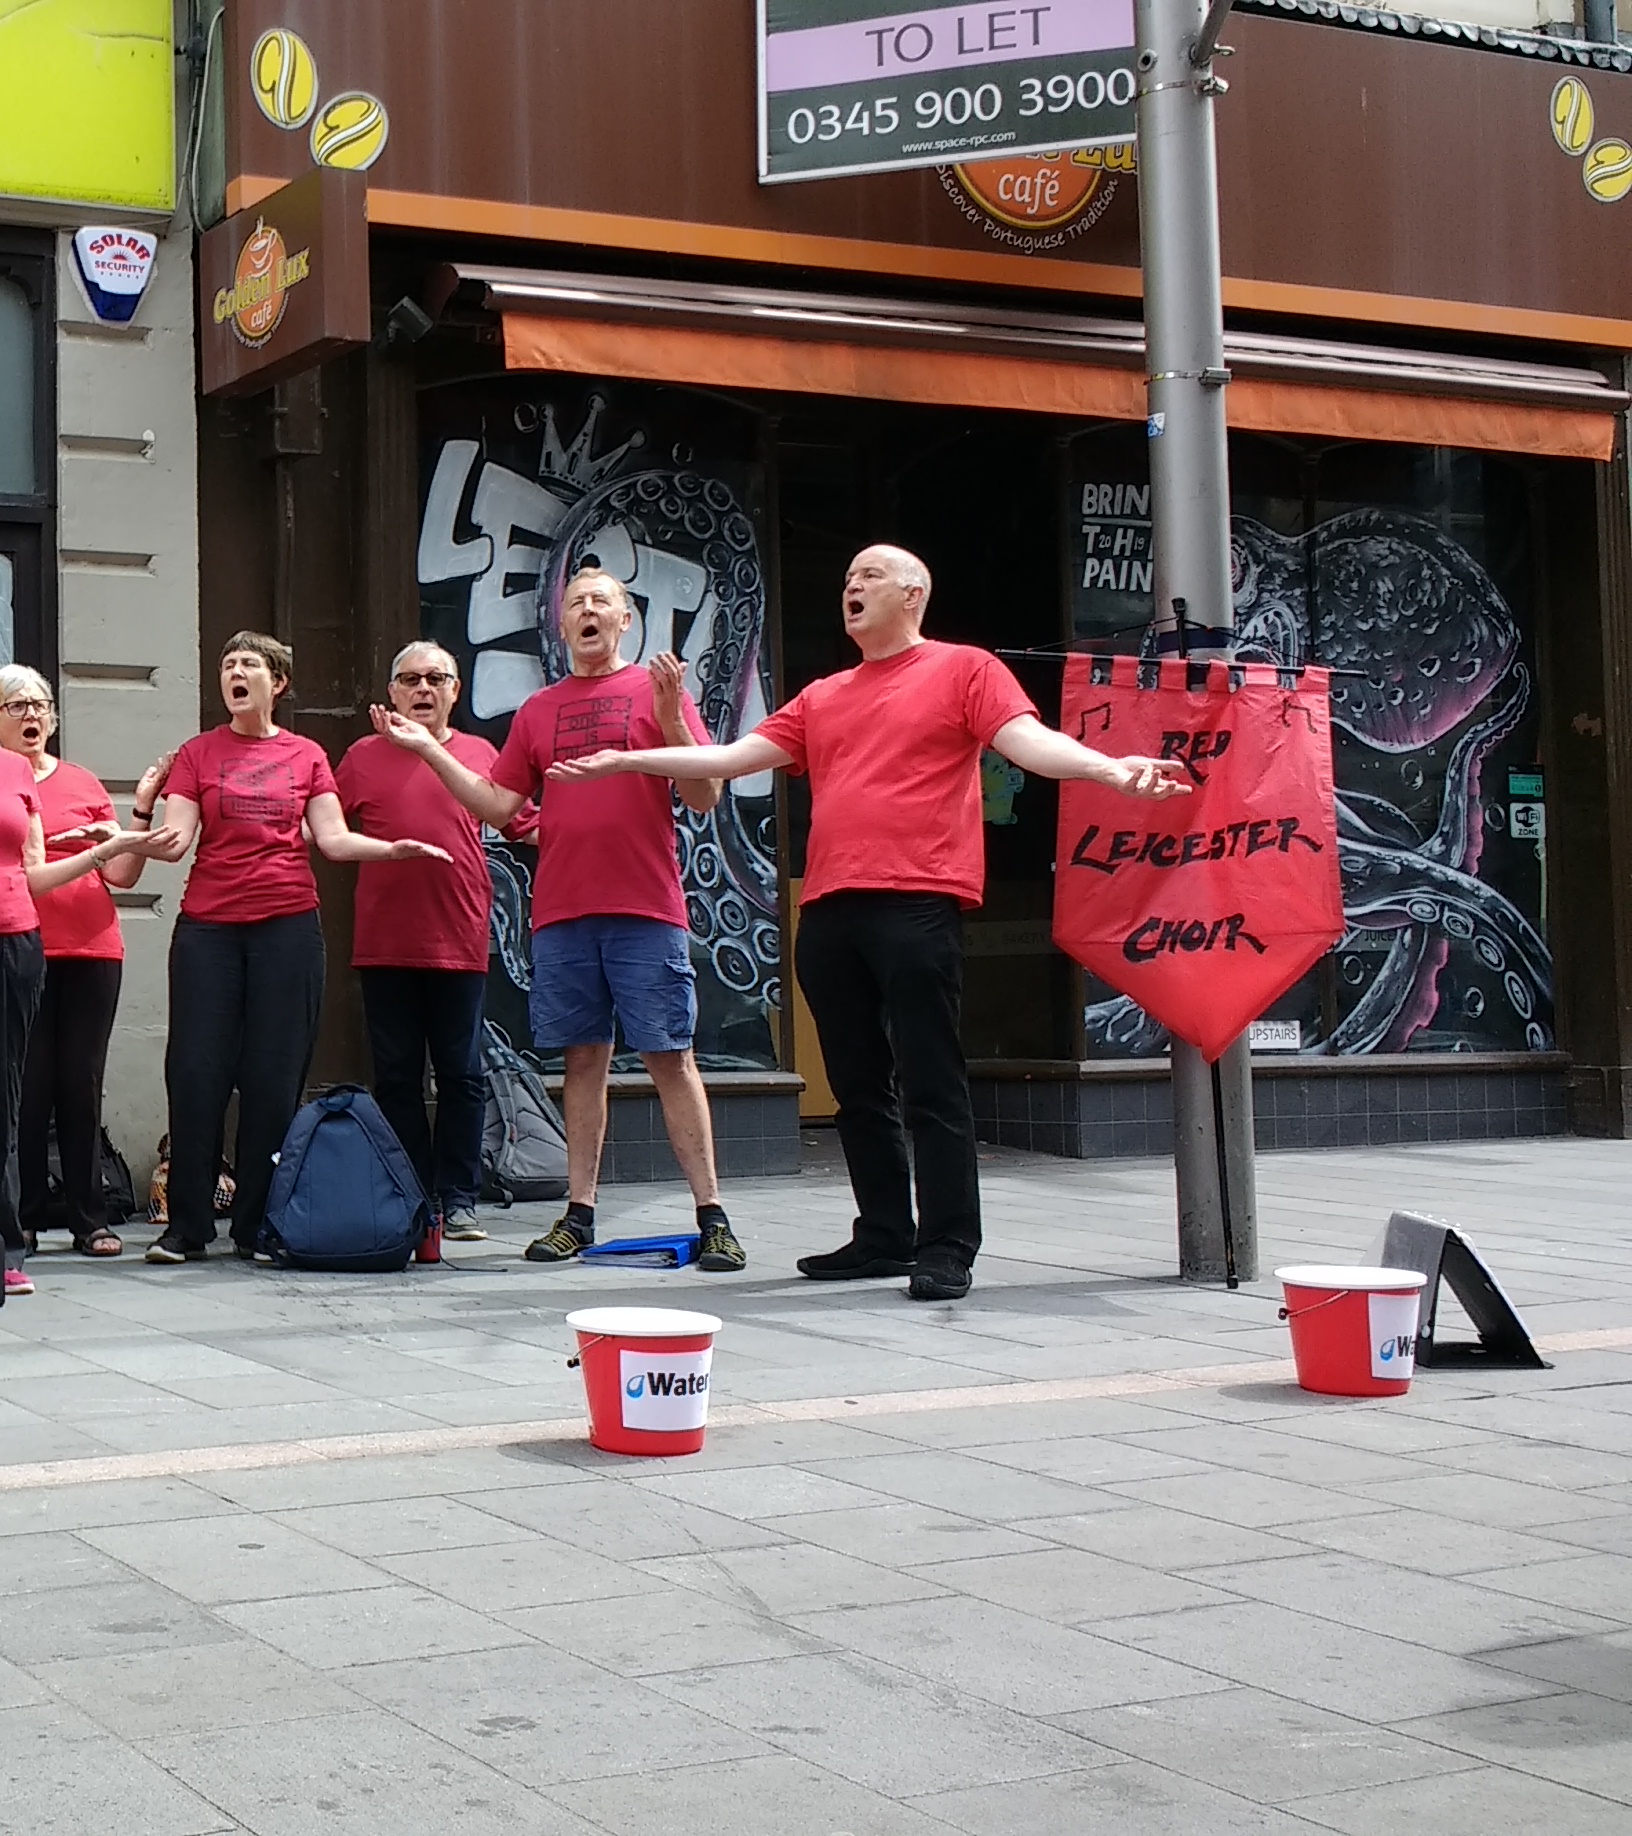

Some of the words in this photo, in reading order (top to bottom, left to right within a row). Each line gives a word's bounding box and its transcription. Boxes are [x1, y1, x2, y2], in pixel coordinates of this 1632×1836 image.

[865, 22, 934, 67] TO
[956, 6, 1051, 56] LET
[786, 96, 900, 144] 0345
[914, 83, 1003, 130] 900
[1018, 67, 1136, 117] 3900
[901, 131, 1016, 154] www.space-rpc.com
[998, 168, 1060, 215] café
[983, 217, 1066, 254] Portuguese
[1065, 178, 1118, 240] Tradition
[89, 233, 151, 260] SOLAR
[94, 260, 145, 274] SECURITY
[213, 269, 272, 325] Golden
[275, 247, 310, 293] Lux
[1081, 483, 1151, 516] BRIN
[1082, 557, 1153, 593] PAIN
[1160, 730, 1232, 786] RED
[1070, 816, 1324, 875] LEICESTER
[1518, 828, 1539, 836] ZONE
[1122, 912, 1268, 964] CHOIR
[647, 1371, 709, 1396] Water
